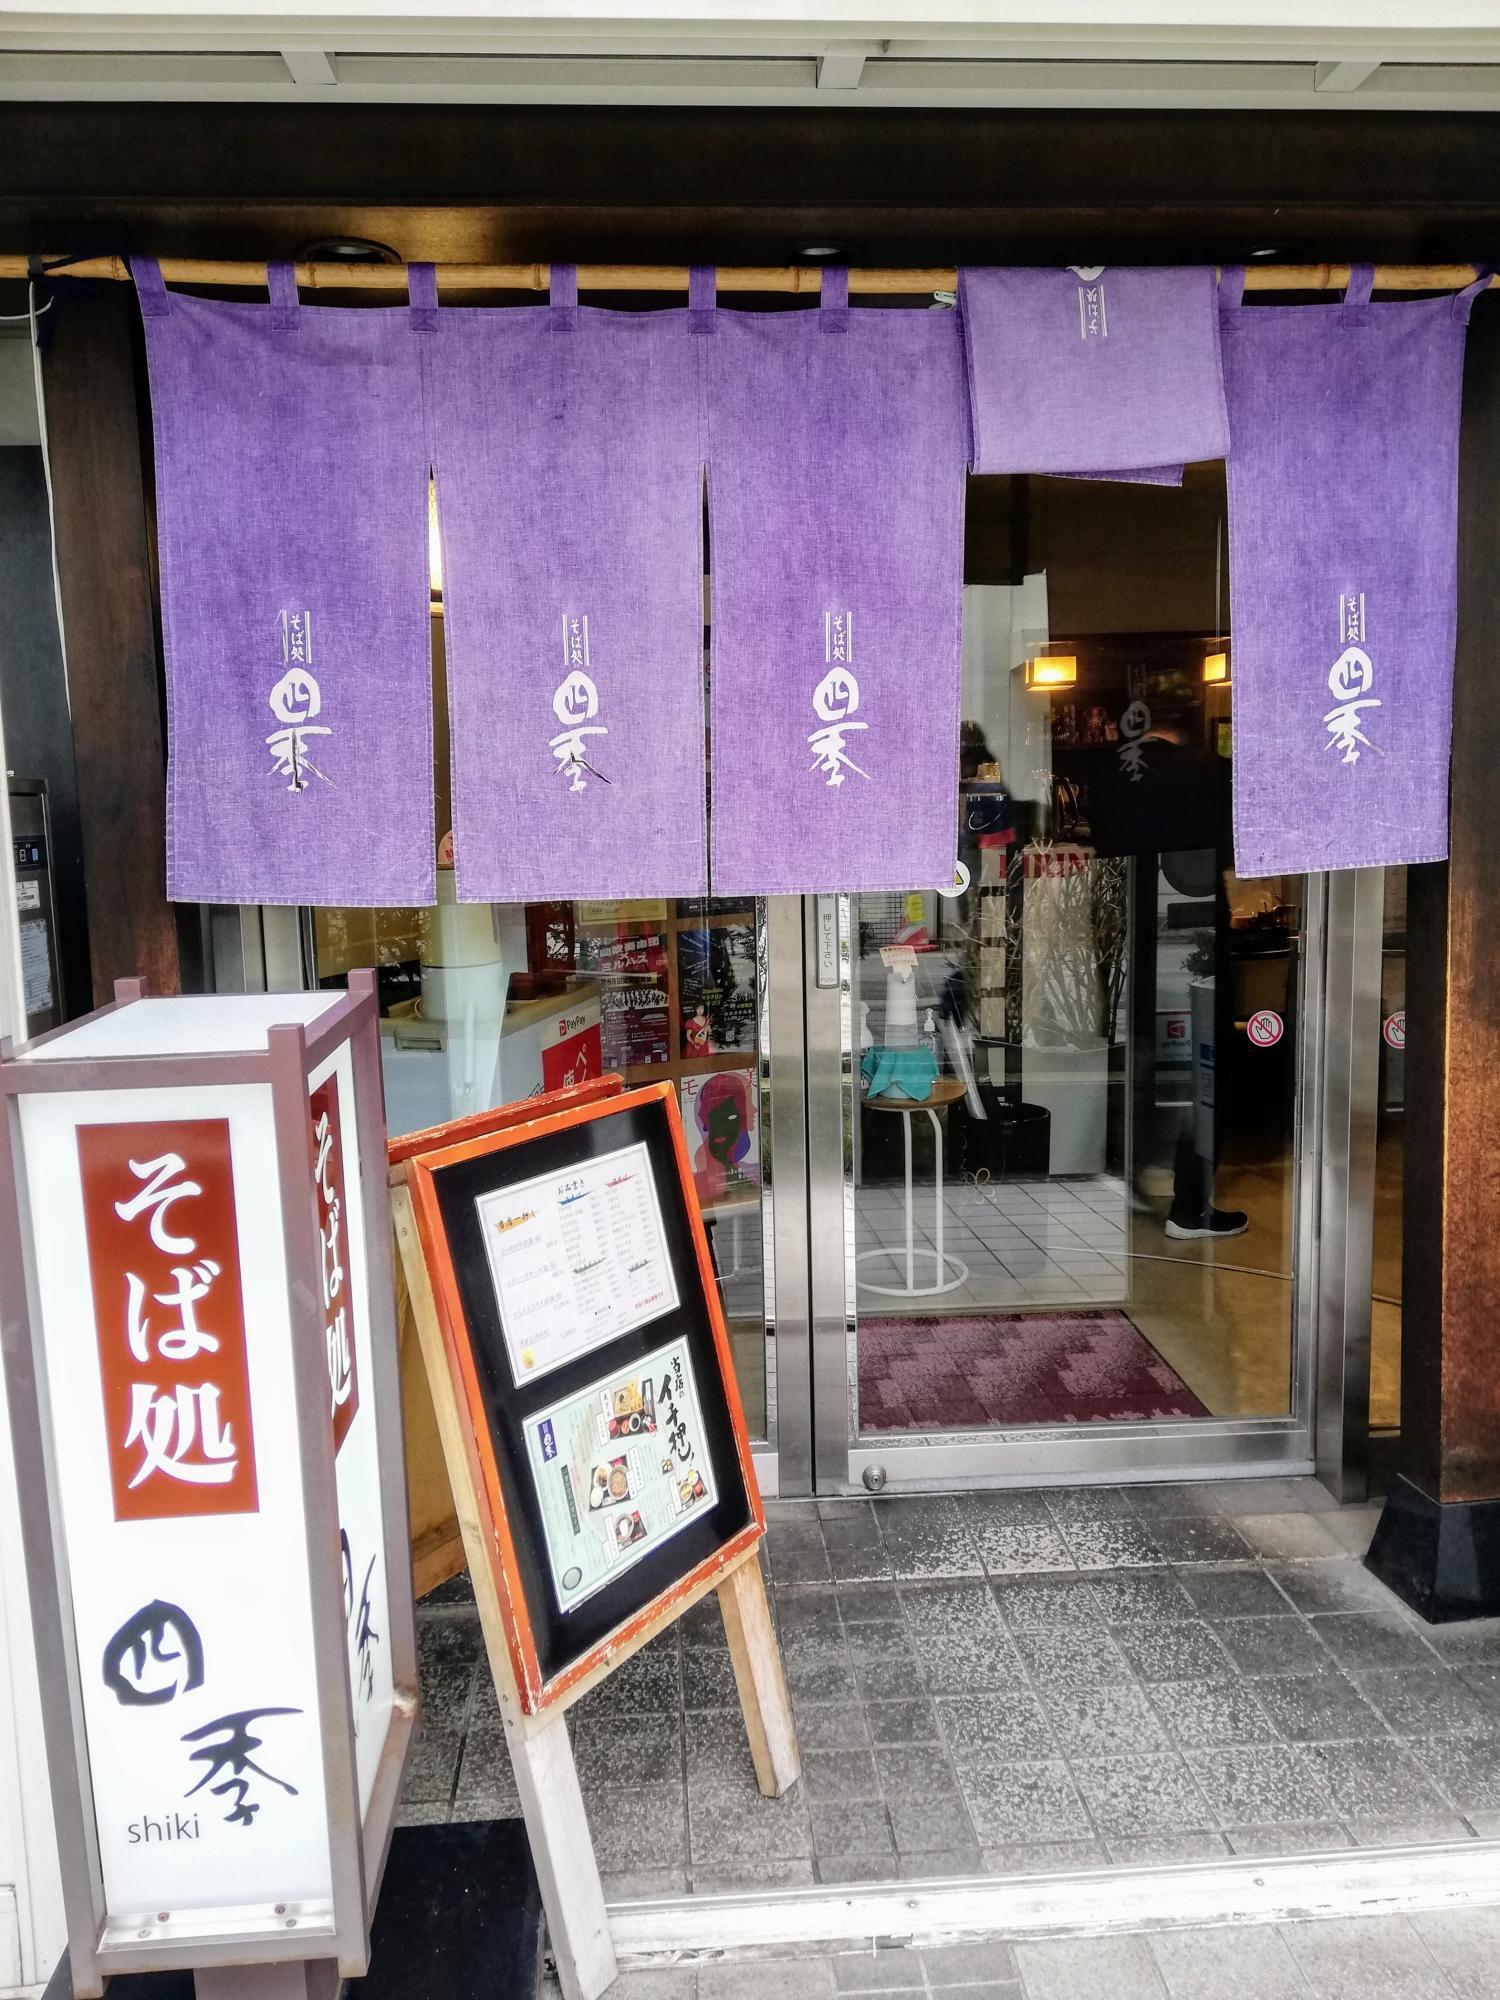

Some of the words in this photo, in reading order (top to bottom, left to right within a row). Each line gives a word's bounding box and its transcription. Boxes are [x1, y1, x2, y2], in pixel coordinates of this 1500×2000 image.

[290, 615, 304, 662] そば処
[569, 618, 582, 666] そば処
[834, 616, 847, 662] そば処
[1347, 598, 1360, 642] そば処
[267, 668, 336, 793] 四季
[550, 670, 612, 791] 四季
[808, 667, 872, 788] 四季
[1322, 646, 1384, 766] 四季
[823, 914, 832, 967] 押して下さい
[566, 1016, 586, 1030] PayPay
[315, 1111, 351, 1419] そば処
[114, 1152, 239, 1490] そば処
[103, 1599, 304, 1827] 四季
[128, 1815, 200, 1844] shiki
